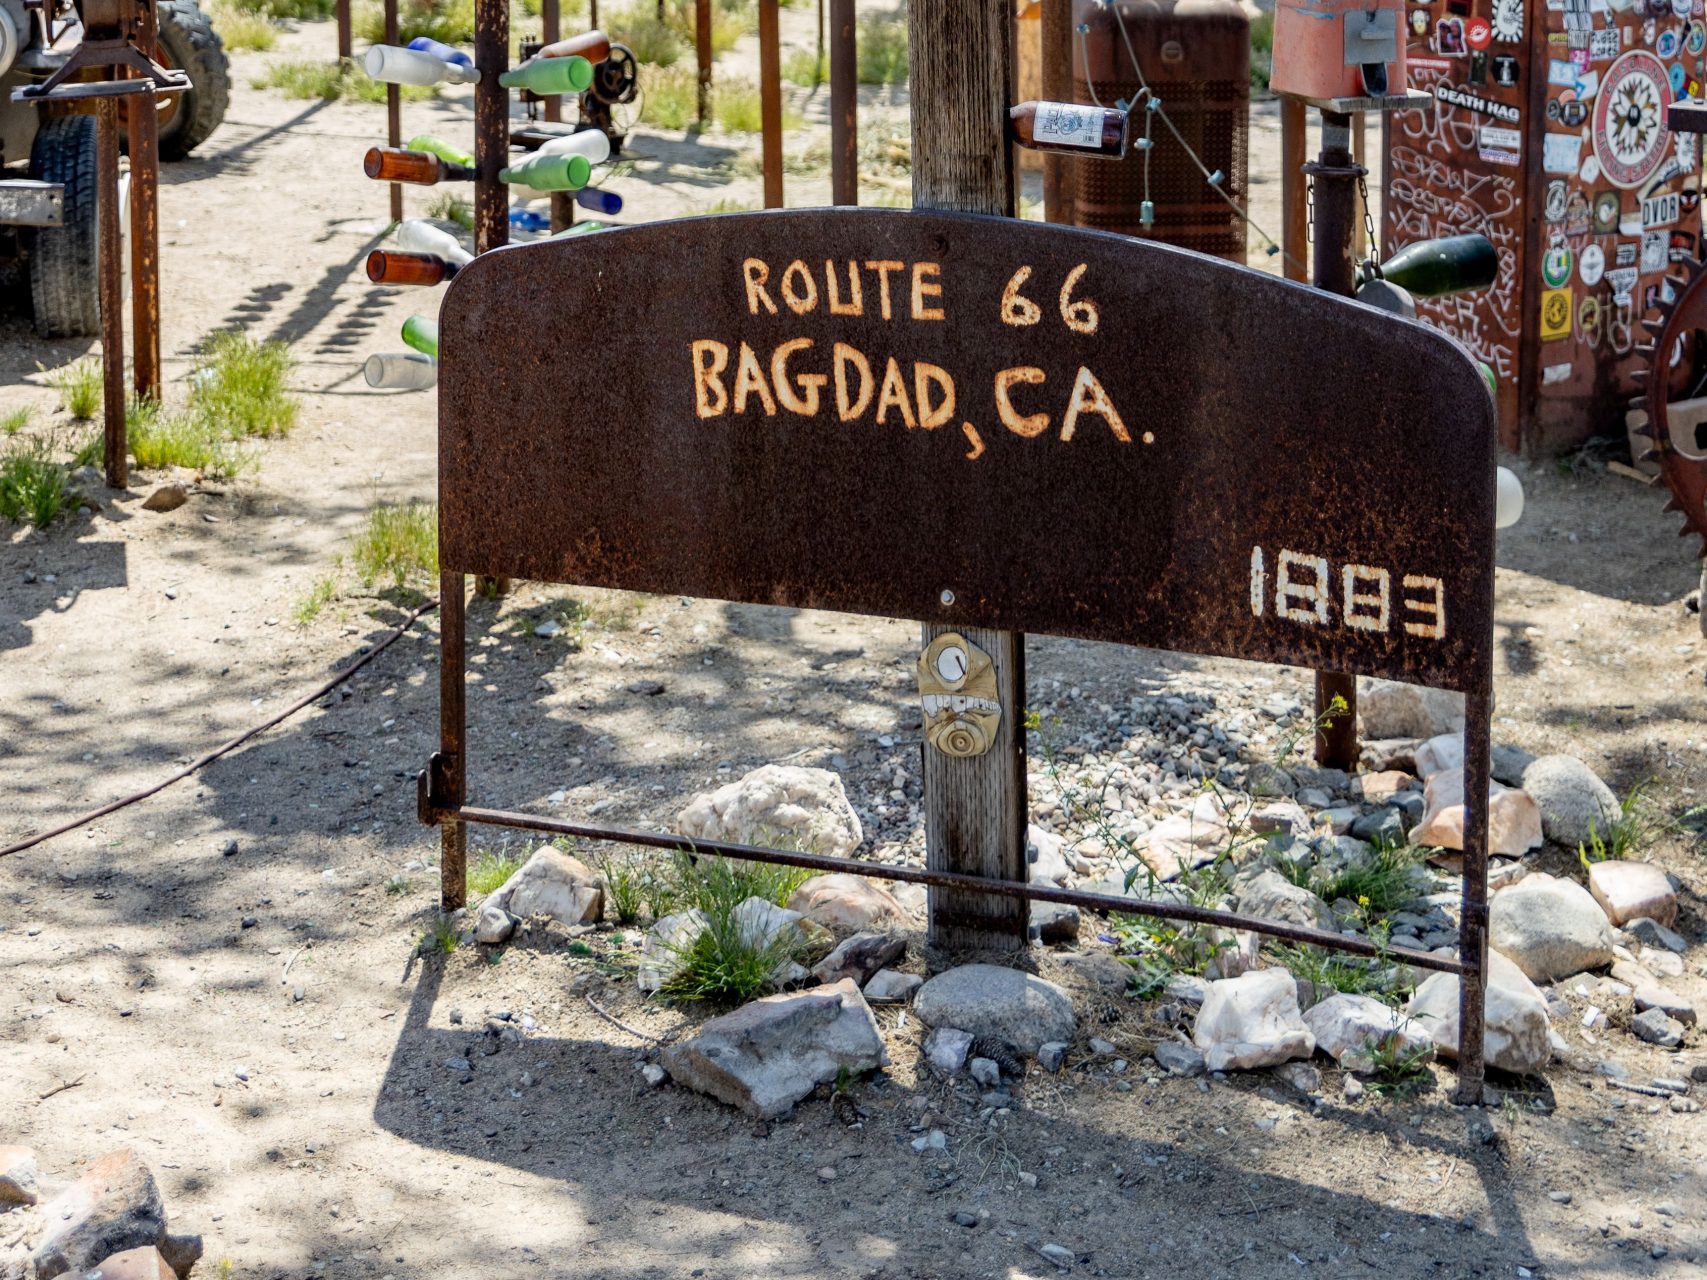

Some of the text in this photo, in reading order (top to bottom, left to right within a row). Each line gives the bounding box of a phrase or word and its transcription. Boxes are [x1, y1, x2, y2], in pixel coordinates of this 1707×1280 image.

[1437, 86, 1520, 121] DEATH HAG
[1606, 58, 1666, 96] GASOLINE
[1643, 198, 1677, 226] DVOR
[743, 257, 1100, 336] ROUTE 66
[691, 337, 1155, 460] BAGDAD, CA.
[1250, 545, 1446, 640] 1883
